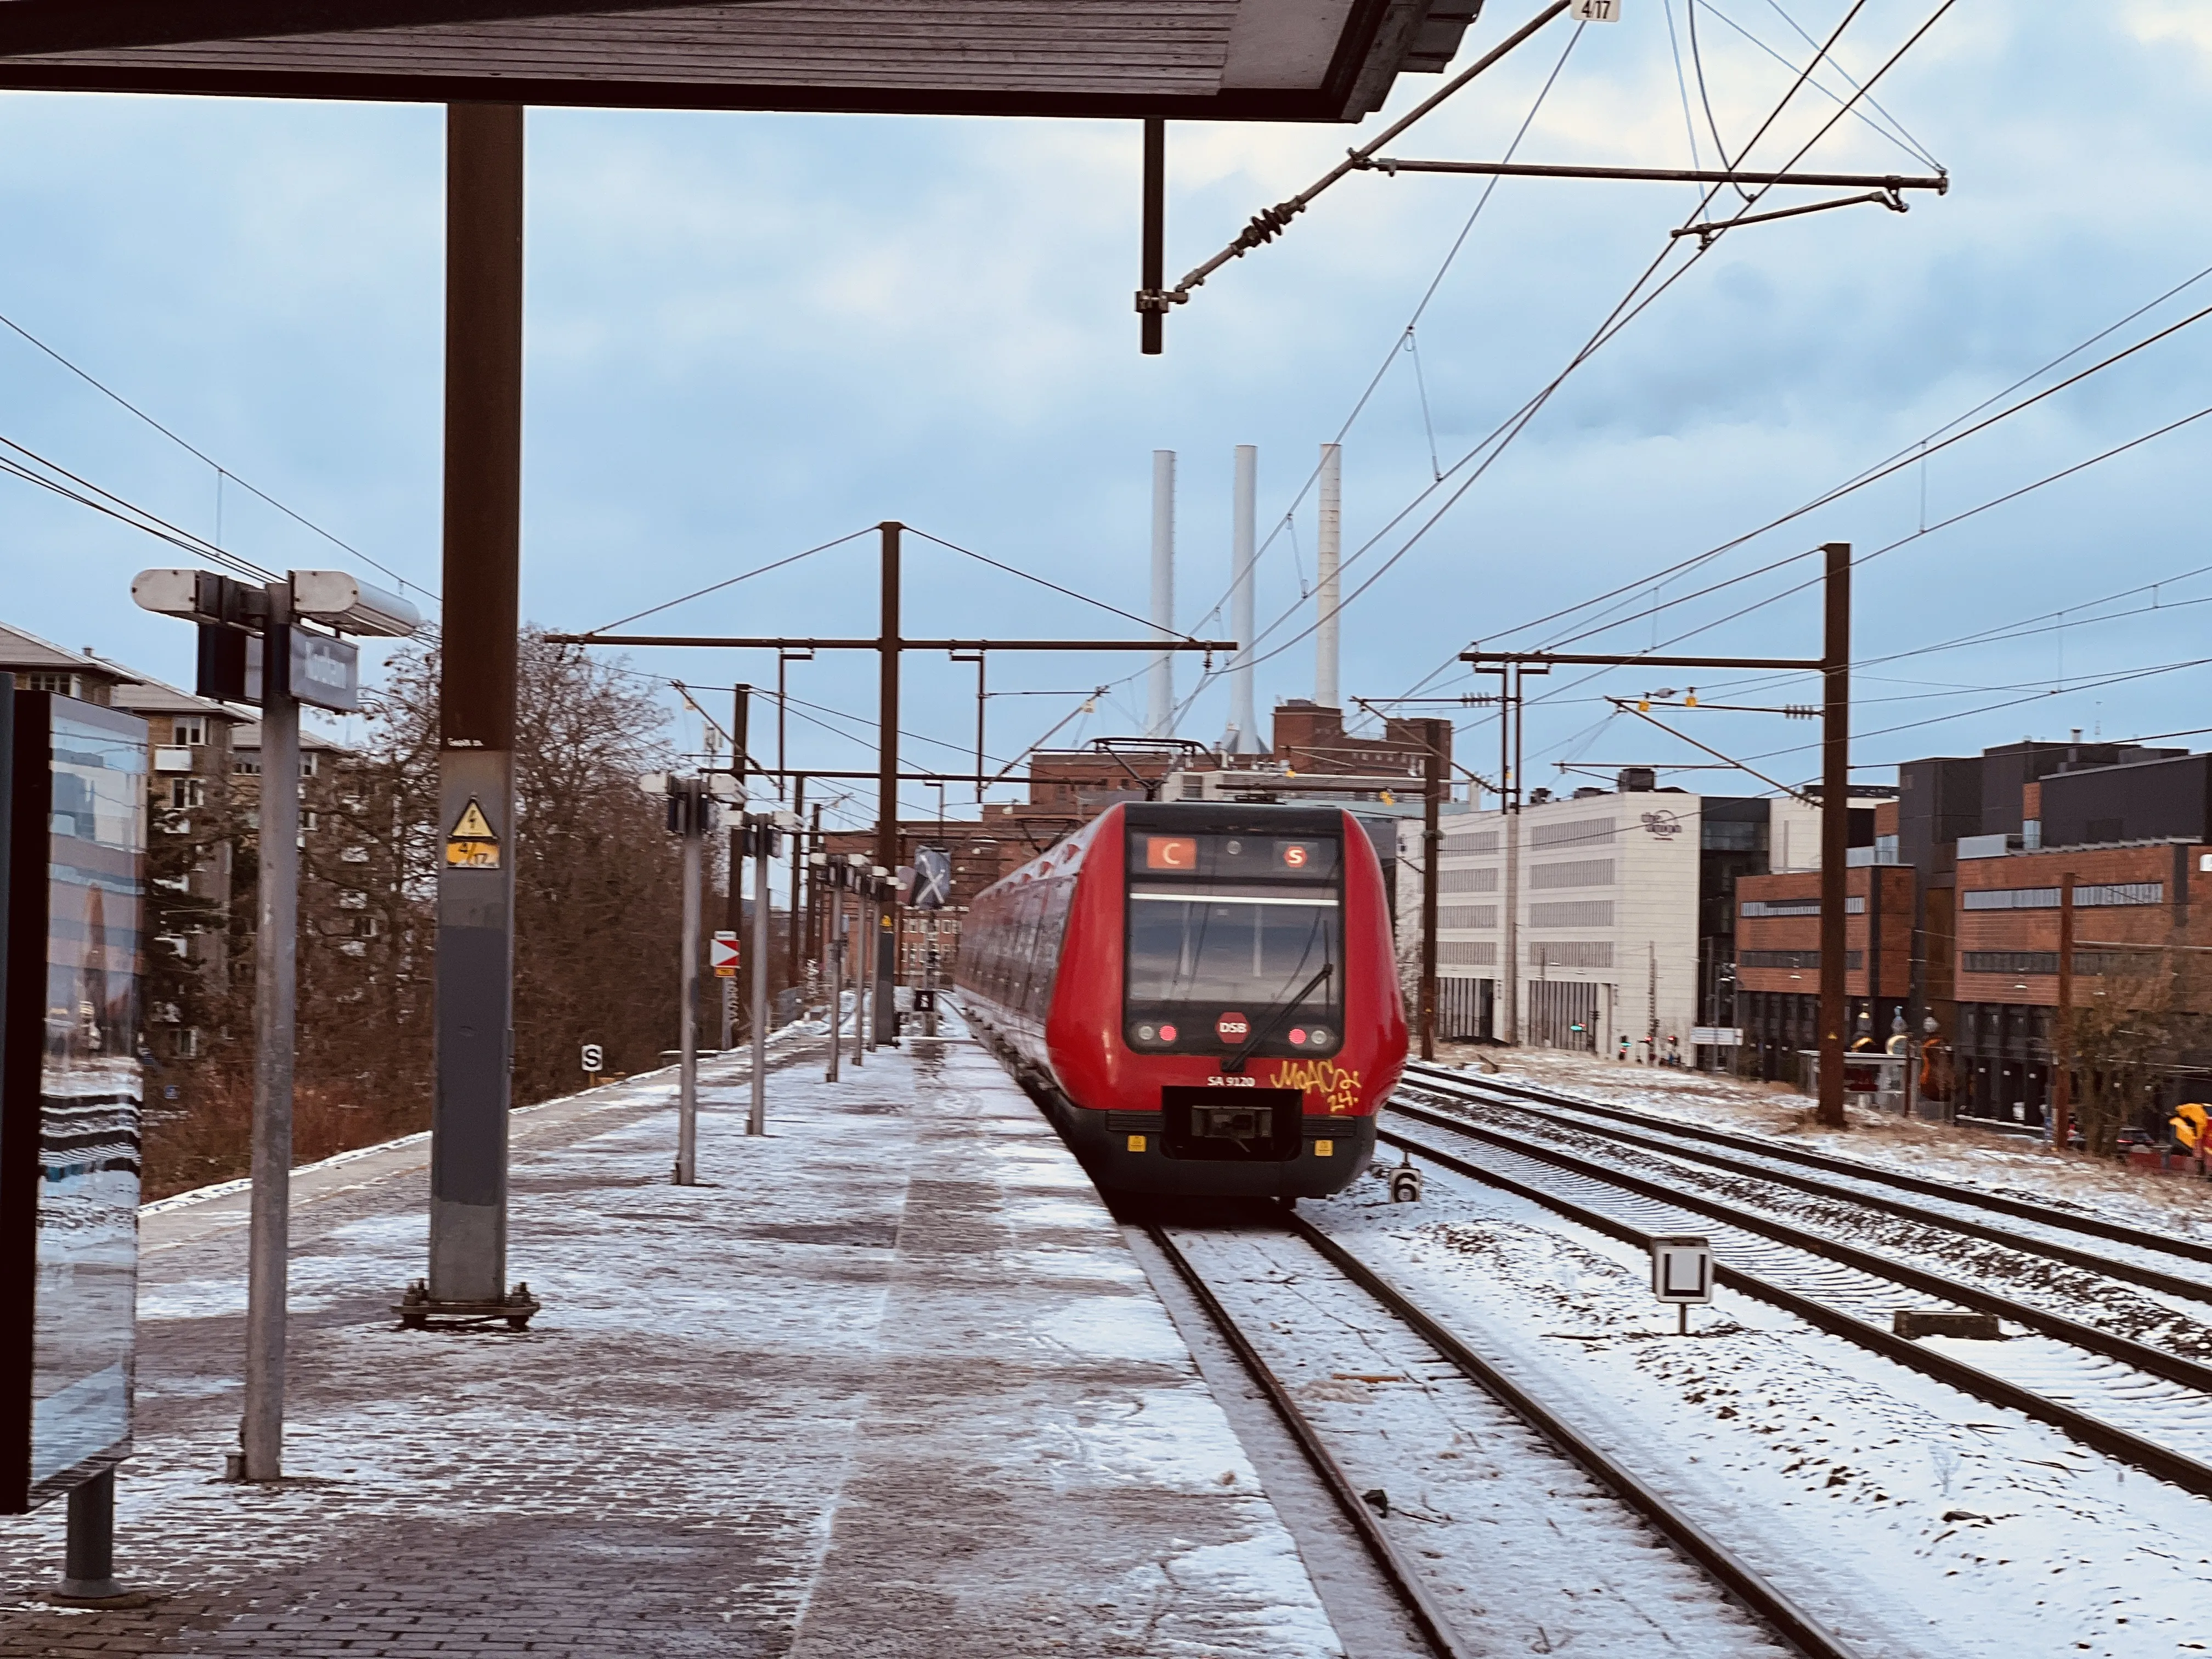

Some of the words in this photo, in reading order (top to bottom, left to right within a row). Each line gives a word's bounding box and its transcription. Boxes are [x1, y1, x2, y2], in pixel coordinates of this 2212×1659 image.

[1163, 843, 1180, 865] C
[1288, 850, 1303, 864] S
[1220, 1022, 1247, 1033] DSB
[584, 1048, 600, 1068] S
[1207, 1076, 1224, 1086] SA
[1393, 1172, 1417, 1203] 6
